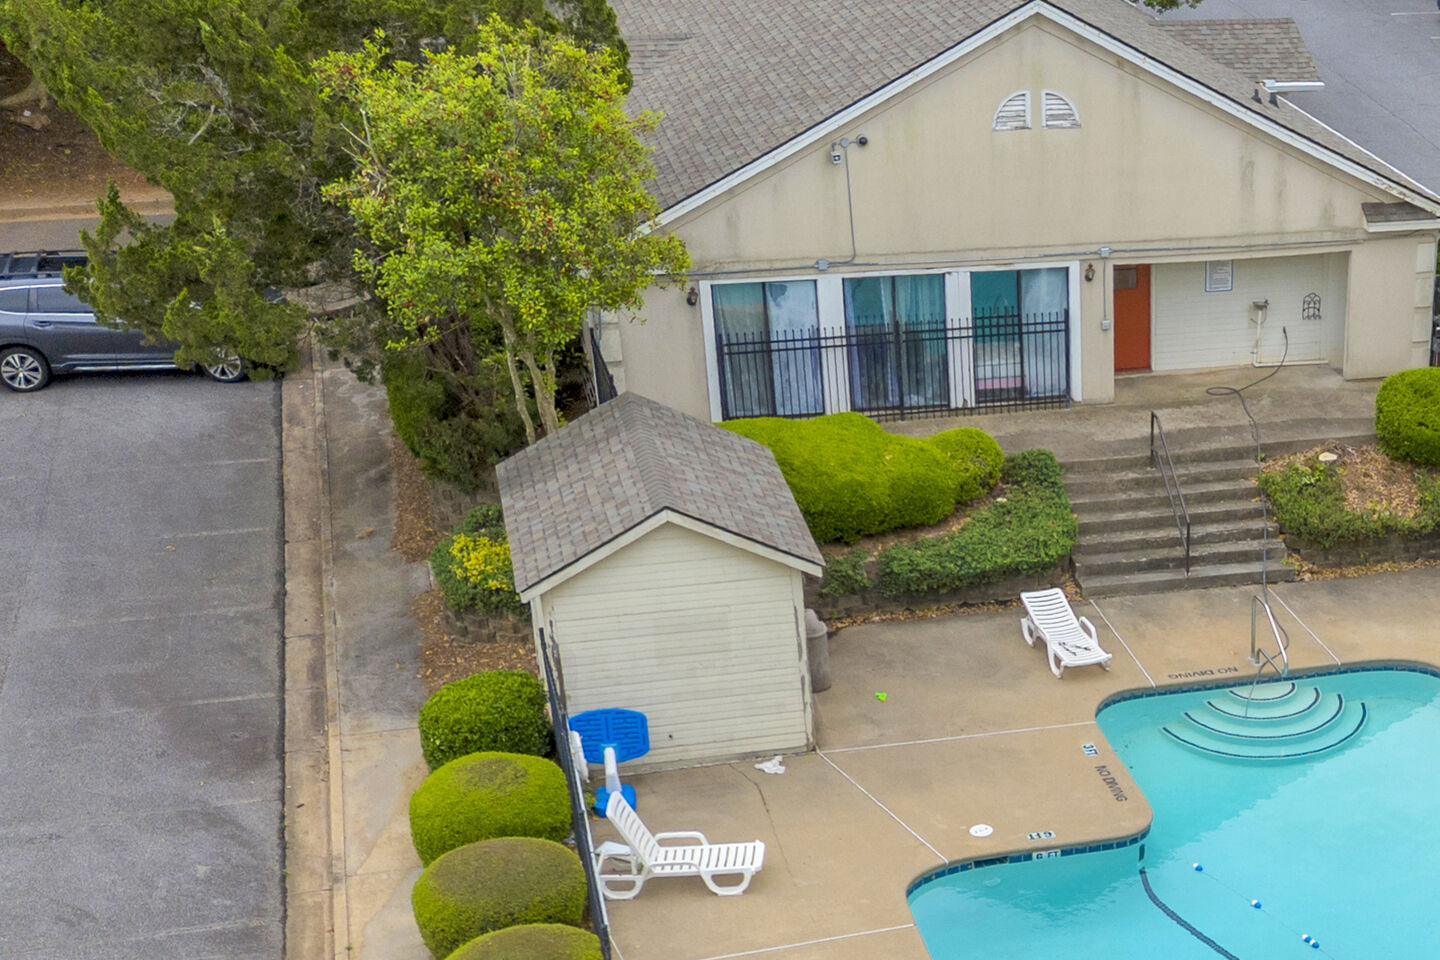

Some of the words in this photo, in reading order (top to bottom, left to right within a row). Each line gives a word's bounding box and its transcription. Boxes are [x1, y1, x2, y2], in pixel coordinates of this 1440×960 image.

[1168, 669, 1215, 679] DIVING
[1217, 666, 1238, 674] NO
[1094, 765, 1111, 777] NO
[1102, 777, 1128, 802] DIVING
